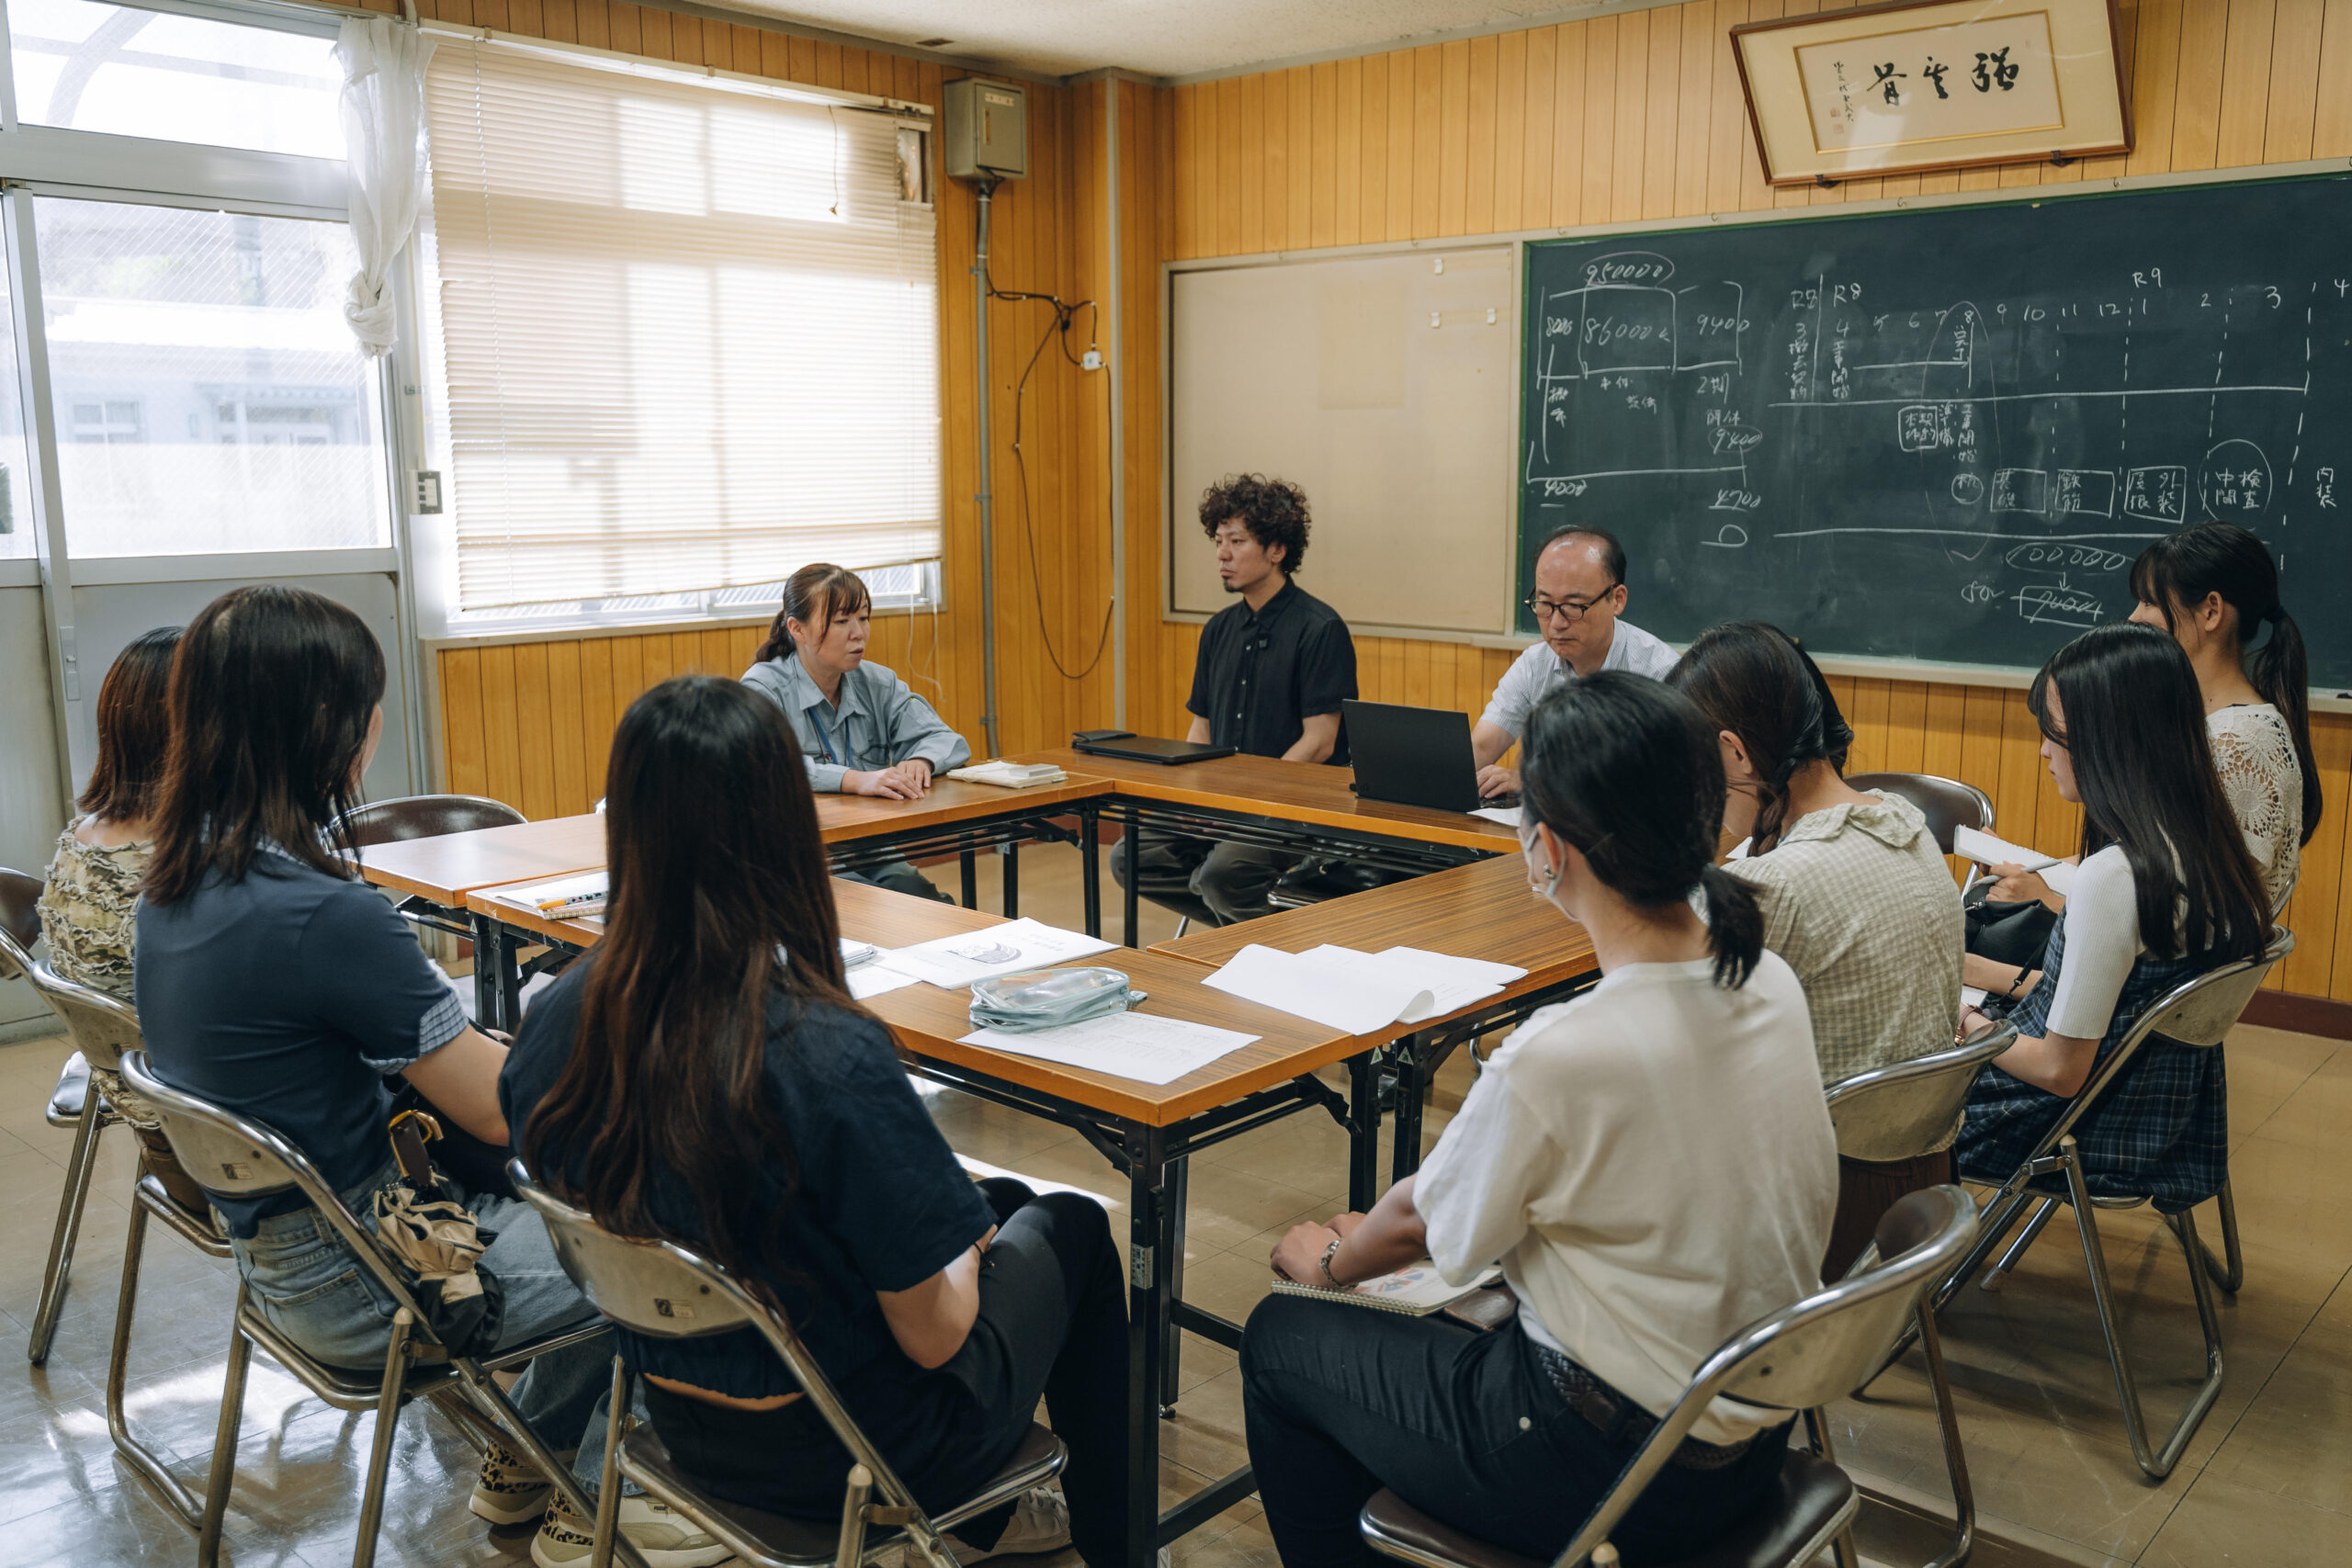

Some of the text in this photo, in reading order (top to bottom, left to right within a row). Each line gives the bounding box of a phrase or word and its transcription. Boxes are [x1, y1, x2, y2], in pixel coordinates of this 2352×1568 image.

[2132, 267, 2162, 288] R9
[1832, 282, 1862, 308] R8
[1836, 318, 1849, 338] 4
[1907, 312, 1921, 329] 6
[1962, 310, 1975, 323] 8
[1996, 303, 2007, 324] 9
[2023, 304, 2046, 321] 10
[2099, 303, 2120, 317] 12
[2199, 293, 2211, 308] 2
[2264, 286, 2282, 310] 3
[2334, 278, 2350, 299] 4
[2316, 466, 2337, 508] 内装
